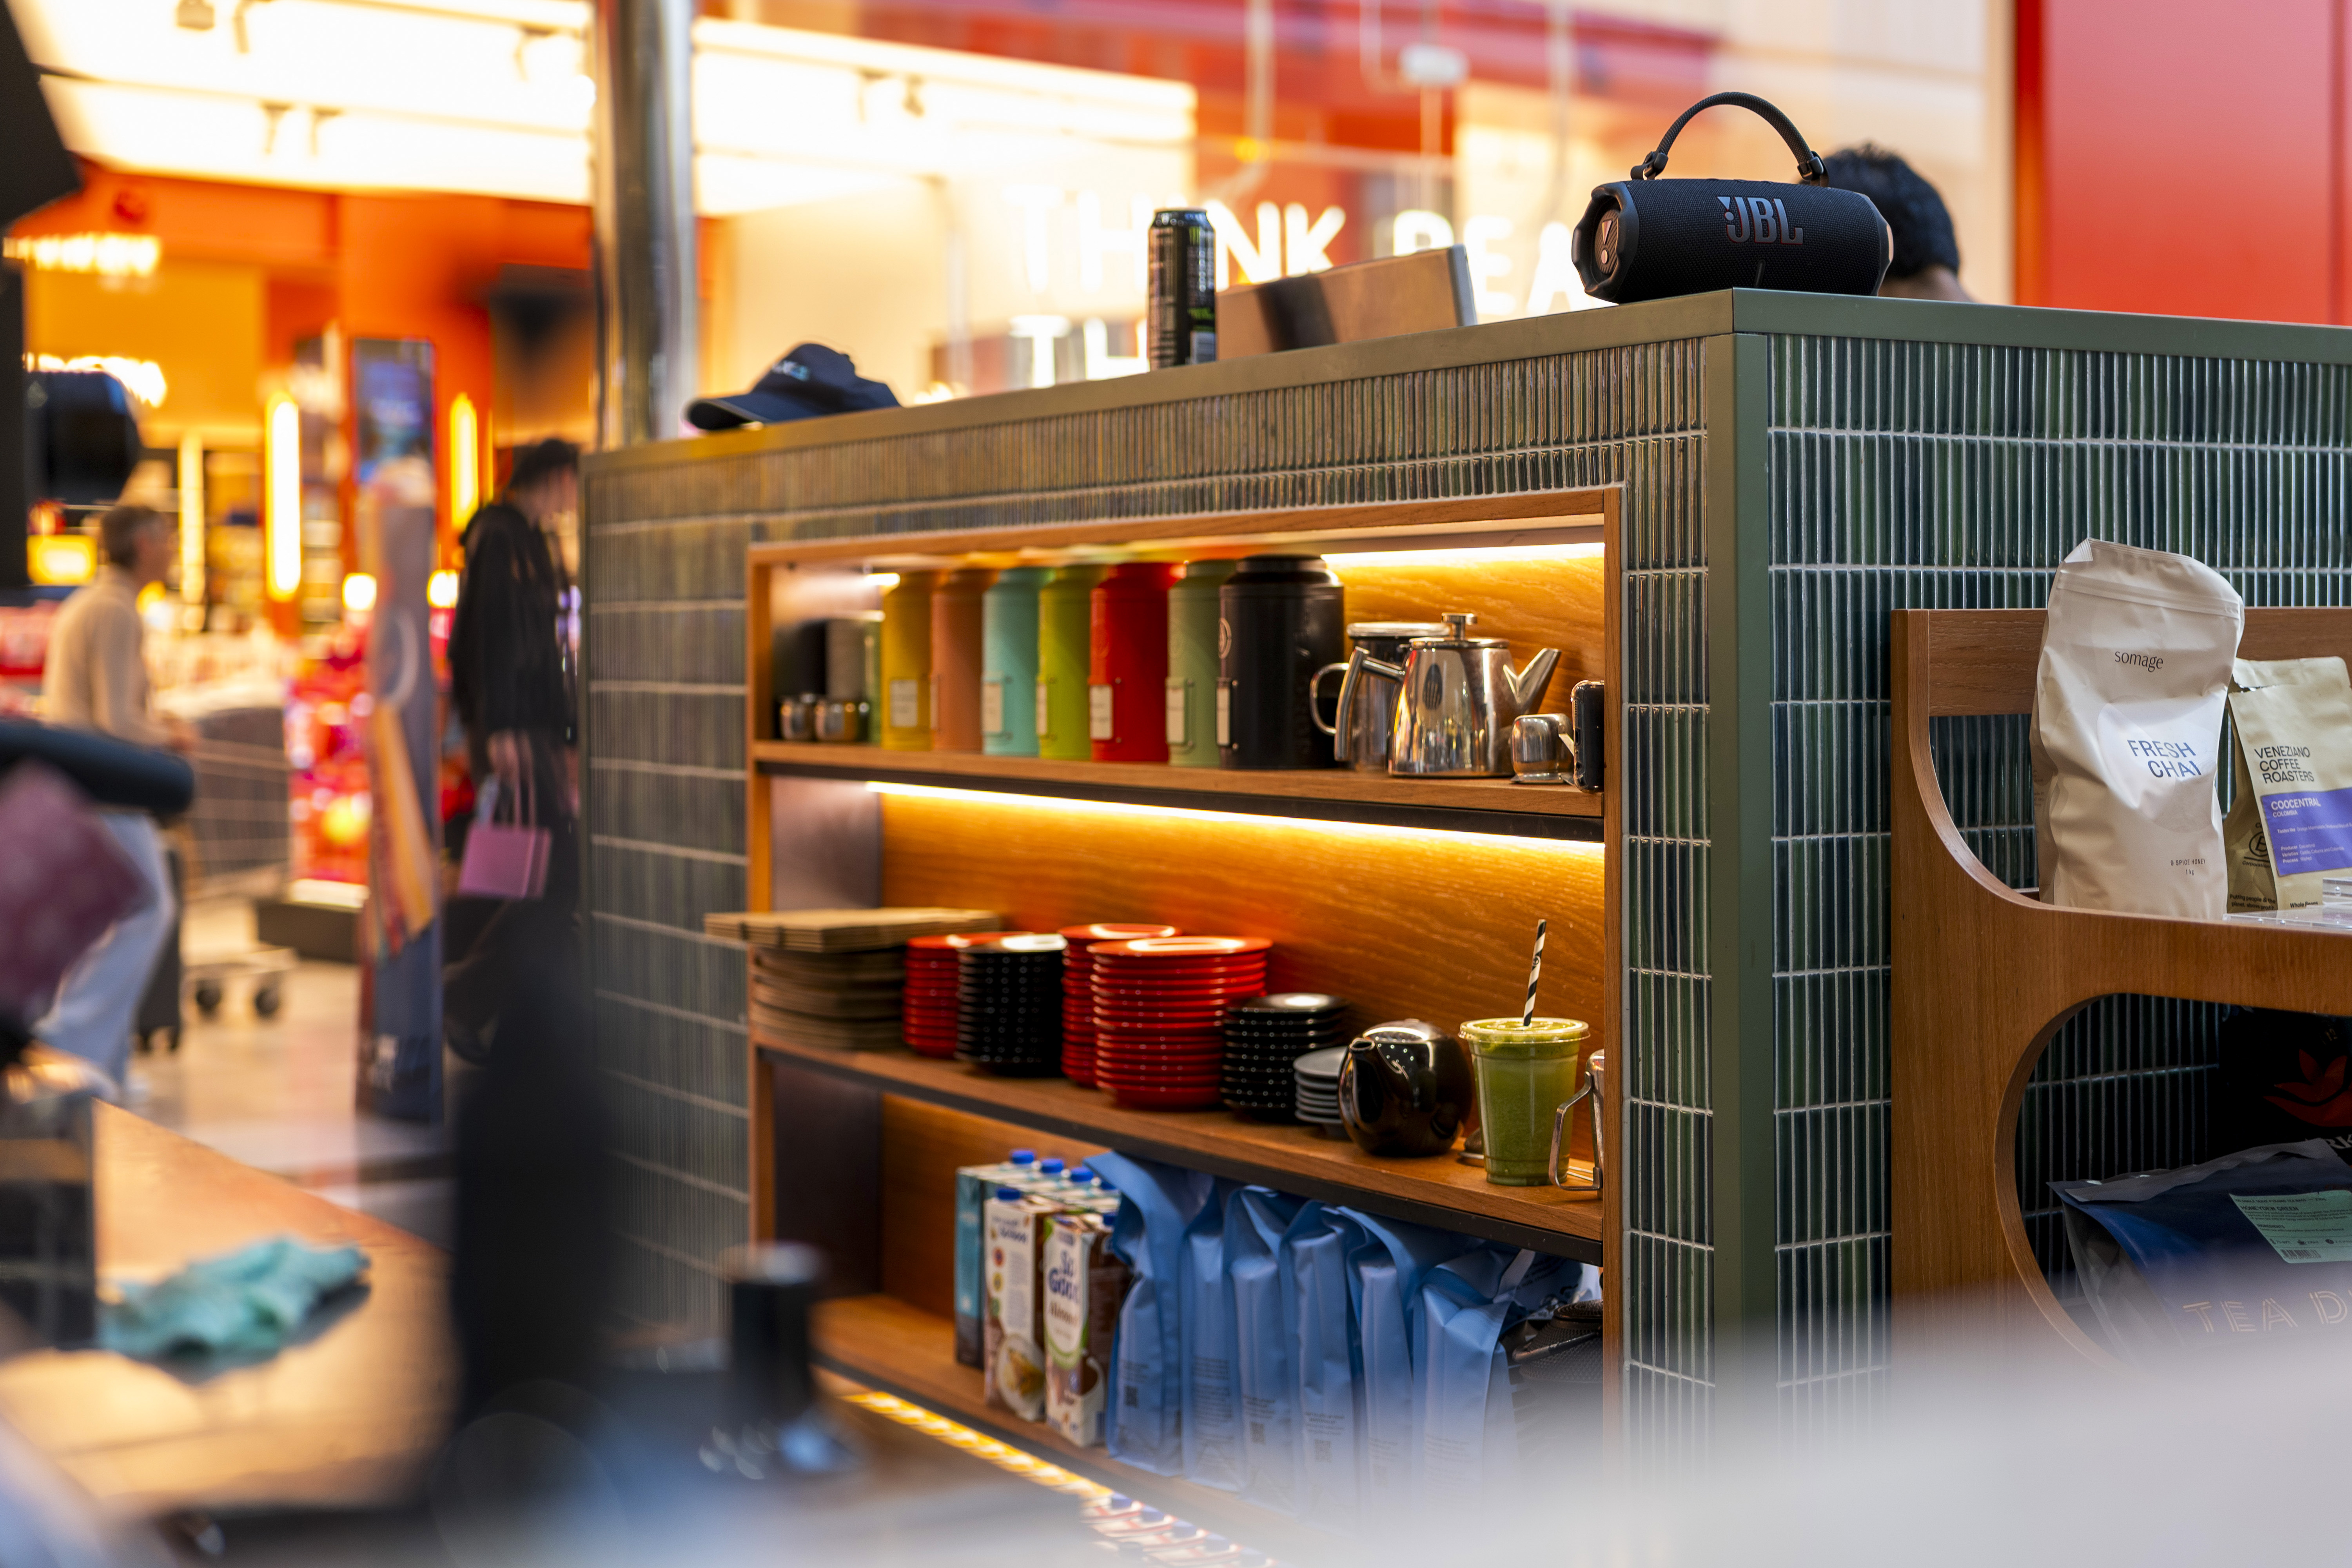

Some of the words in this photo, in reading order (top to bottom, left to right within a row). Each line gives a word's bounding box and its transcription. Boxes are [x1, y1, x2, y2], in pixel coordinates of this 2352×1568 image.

[1719, 196, 1803, 245] JBL
[1002, 184, 1346, 294] THNK
[2114, 651, 2163, 673] somage
[2127, 739, 2197, 758] FRESH
[2254, 746, 2310, 759] VENEZIANO
[2147, 760, 2201, 778] CHAI
[2259, 759, 2301, 772] COFFEE
[2262, 770, 2314, 784] ROASTERS
[2271, 797, 2321, 811] COOCENTRAL
[2272, 809, 2298, 818] COLOMBIA
[2242, 860, 2270, 868] Corporation
[2182, 1297, 2298, 1332] TEA
[2308, 1289, 2352, 1325] D
